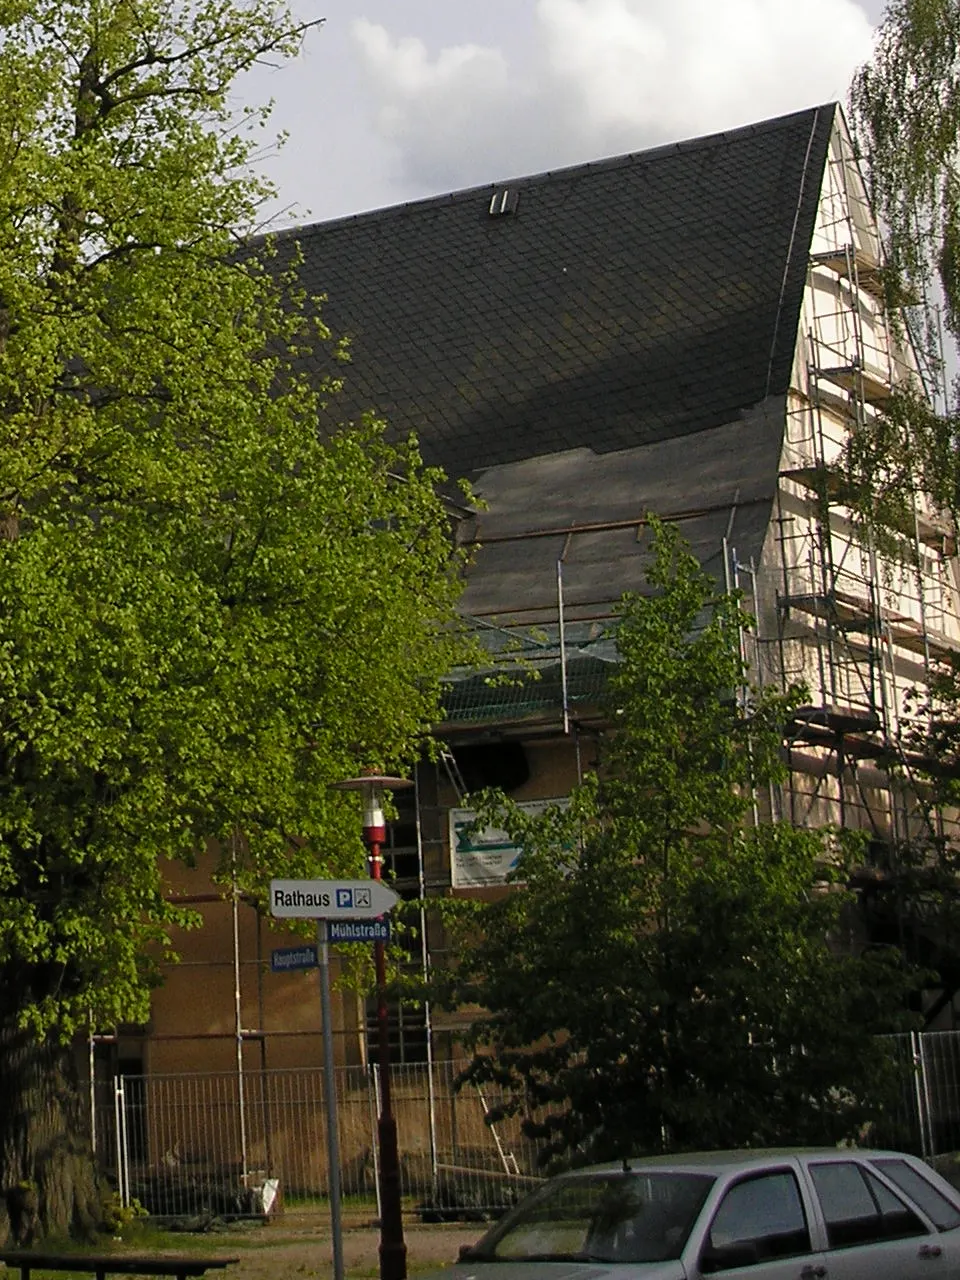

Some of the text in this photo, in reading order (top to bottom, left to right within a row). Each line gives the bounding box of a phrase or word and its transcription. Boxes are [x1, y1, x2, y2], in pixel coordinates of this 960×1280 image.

[274, 889, 351, 907] Rathaus P
[331, 922, 387, 938] Mühlstraße
